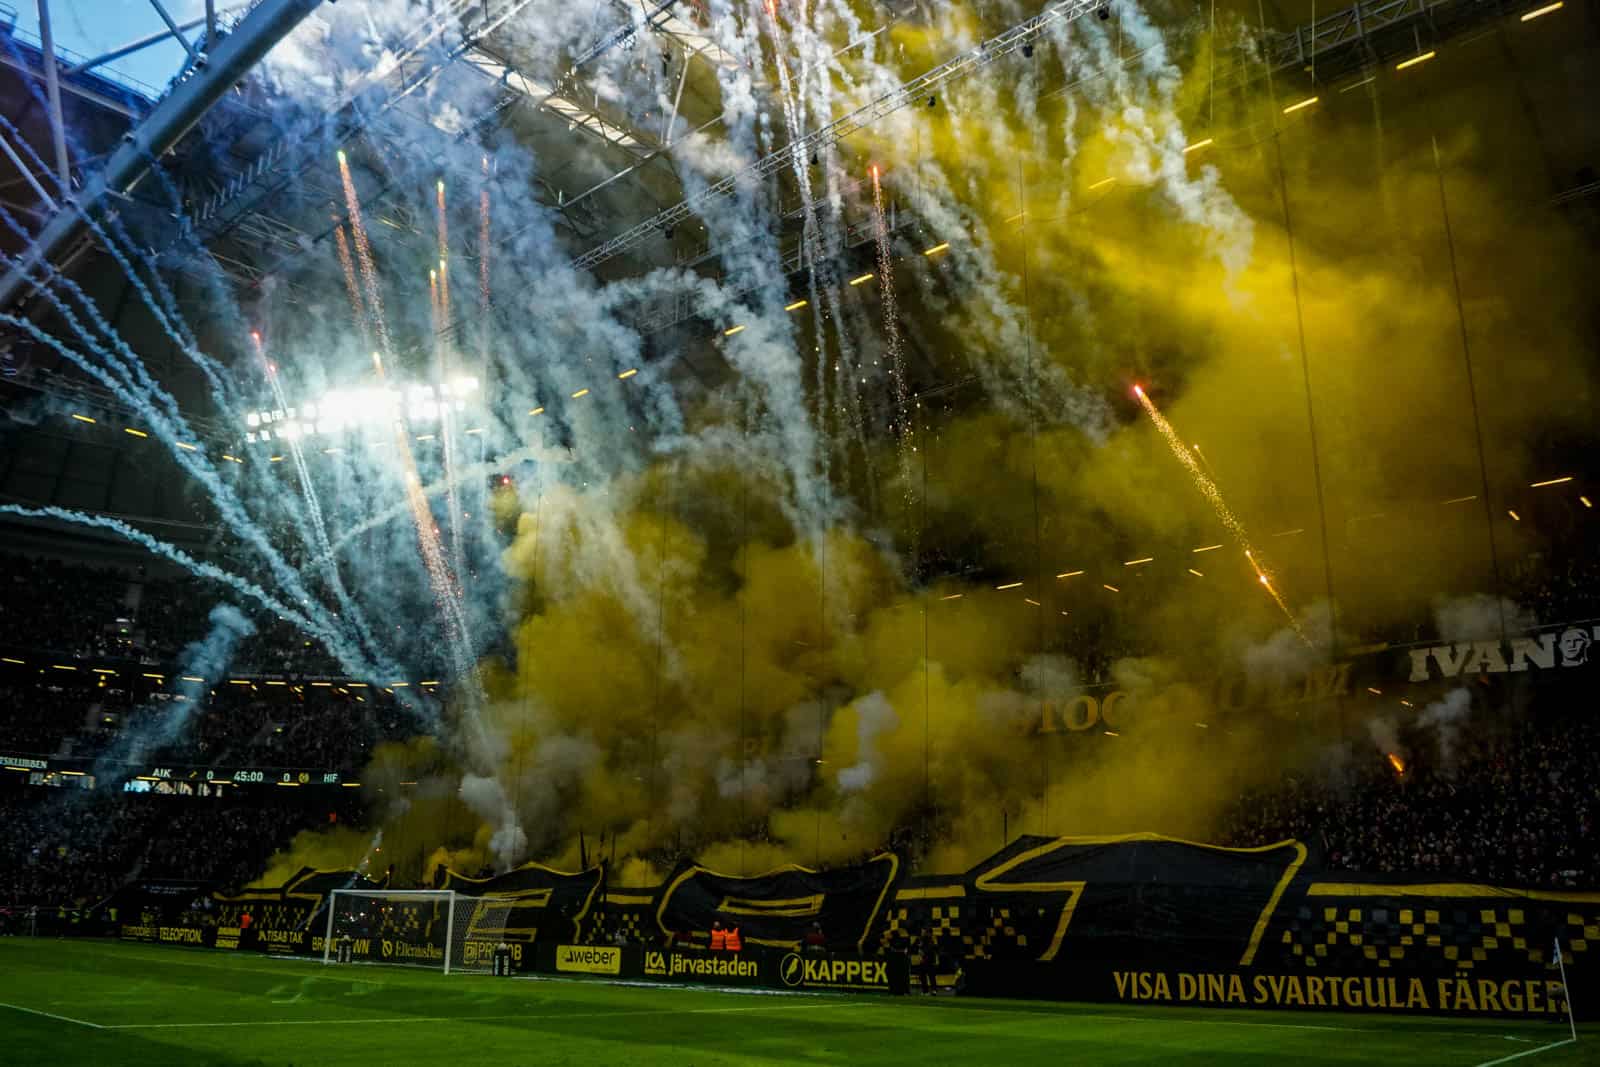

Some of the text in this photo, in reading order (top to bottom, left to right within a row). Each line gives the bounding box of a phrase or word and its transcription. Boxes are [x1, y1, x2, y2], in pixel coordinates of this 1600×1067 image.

[152, 768, 173, 779] AIK
[233, 770, 264, 782] 45:00
[323, 773, 338, 784] HIF
[573, 947, 615, 964] weber
[645, 951, 757, 977] ICA Järvastaden
[804, 958, 888, 984] KAPPEX
[1112, 970, 1172, 1000] VISA
[1177, 972, 1247, 1003] DINA
[1252, 975, 1431, 1009] SVARTGULA
